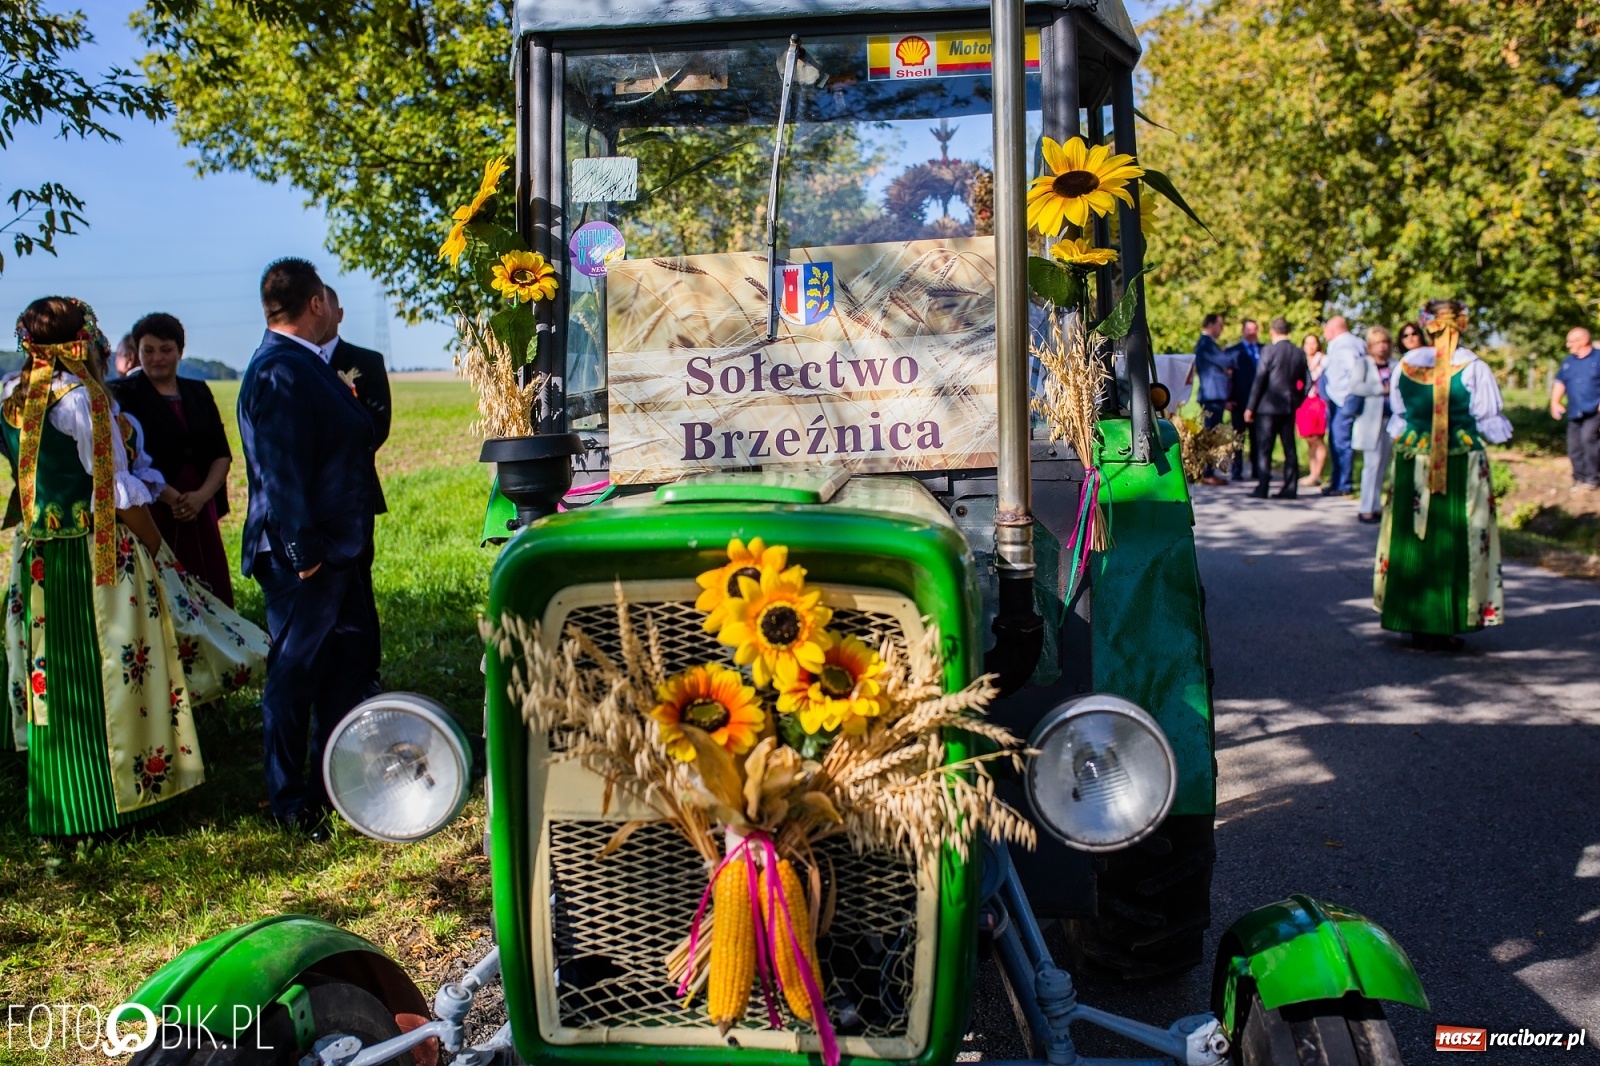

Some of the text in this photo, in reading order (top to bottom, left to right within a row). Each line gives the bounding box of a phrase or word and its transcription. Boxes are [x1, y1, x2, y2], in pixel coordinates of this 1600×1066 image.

[896, 68, 932, 78] Shell
[578, 229, 615, 247] SOFTWARE
[686, 351, 919, 396] Sołectwo
[680, 411, 944, 461] Brzeźnica
